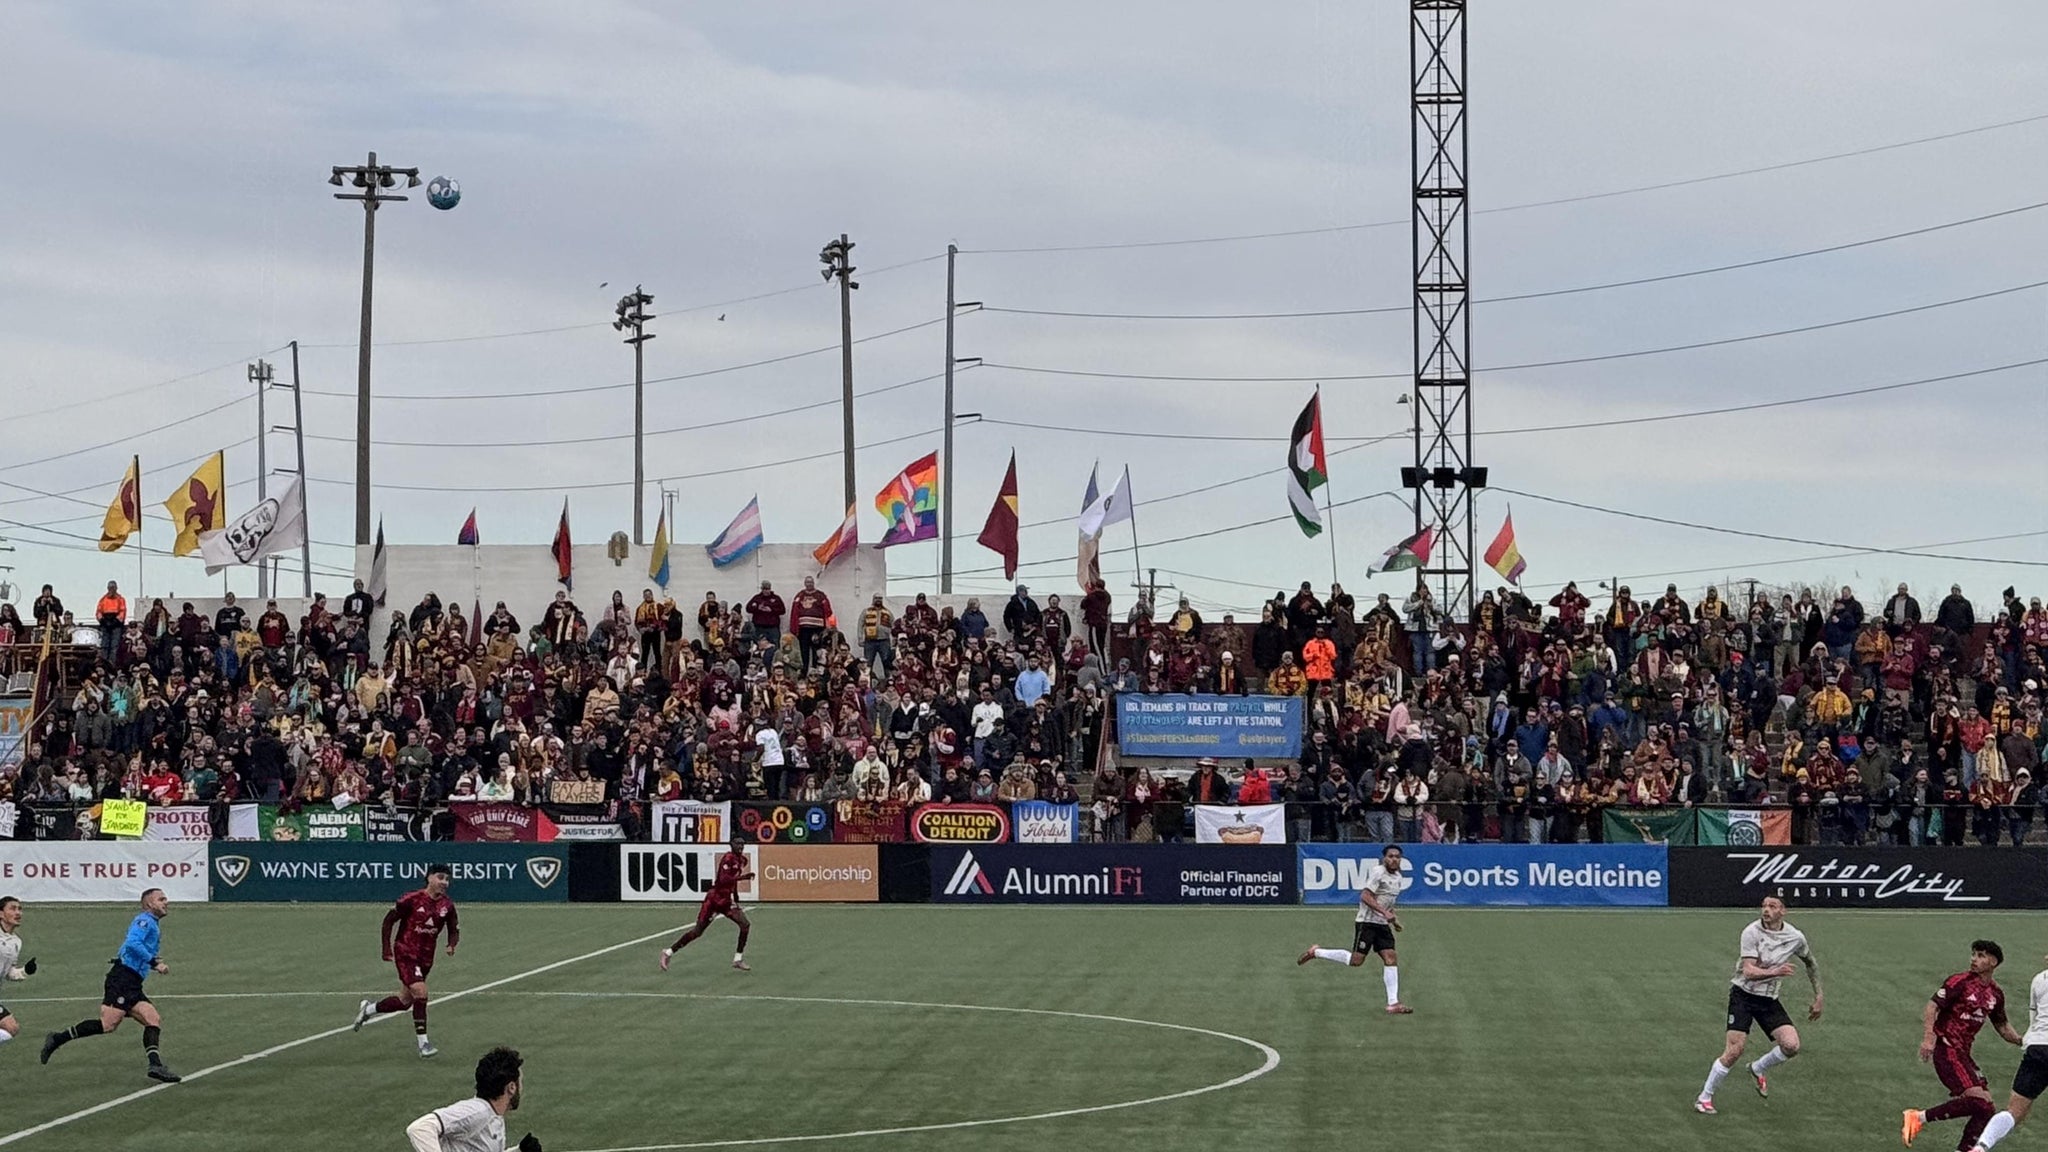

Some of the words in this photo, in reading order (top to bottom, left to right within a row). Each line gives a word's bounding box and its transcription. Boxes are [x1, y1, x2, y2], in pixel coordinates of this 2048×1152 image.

[1126, 702, 1139, 712] USL
[1188, 702, 1211, 712] TRACK
[1213, 702, 1228, 712] FOR
[1264, 703, 1287, 713] WHILE
[1187, 715, 1203, 726] ARE
[1204, 715, 1221, 726] LEFT
[1223, 716, 1233, 726] AT
[1234, 716, 1249, 726] THE
[554, 783, 575, 793] PAY
[309, 813, 361, 825] AMERICA
[923, 814, 997, 827] COALITION
[309, 827, 348, 838] NEEDS
[379, 822, 395, 832] not
[930, 826, 990, 839] DETROIT
[1022, 822, 1067, 837] Abolish
[23, 863, 70, 878] ONE
[80, 863, 137, 878] TRUE
[260, 862, 329, 879] WAYNE
[336, 862, 393, 879] STATE
[399, 862, 518, 879] UNERSITY
[627, 852, 713, 893] USL
[764, 865, 872, 883] Championship
[1180, 870, 1223, 882] Official
[1226, 870, 1283, 882] Financial
[1424, 861, 1519, 887] Sports
[1528, 861, 1662, 887] Medicine
[1180, 884, 1226, 897] Partner
[1229, 884, 1243, 896] of
[1245, 884, 1279, 897] DCFC
[1777, 887, 1866, 898] CASINO
